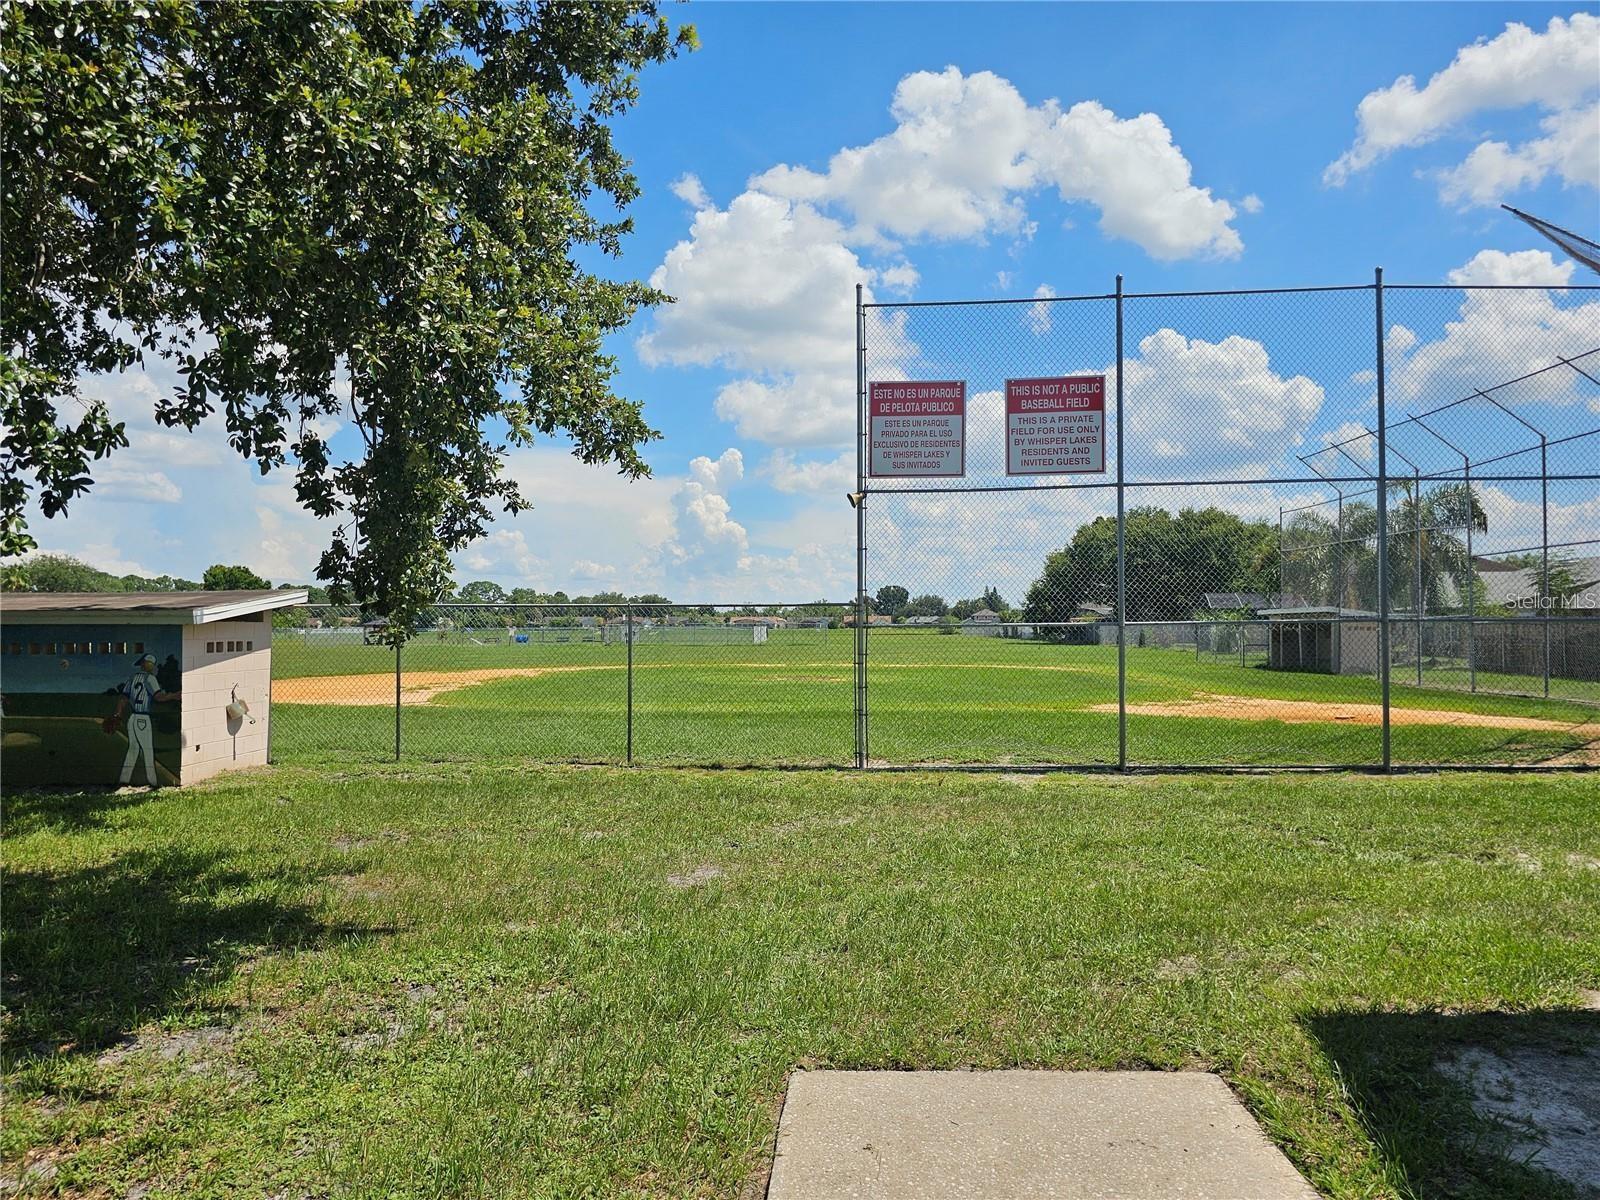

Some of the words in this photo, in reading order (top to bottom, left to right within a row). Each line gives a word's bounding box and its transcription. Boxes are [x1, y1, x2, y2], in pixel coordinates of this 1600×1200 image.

[874, 390, 892, 399] ESTE
[894, 389, 905, 398] NO
[907, 389, 916, 398] ES
[918, 389, 928, 398] UN
[931, 388, 960, 398] PARQUE
[1011, 386, 1030, 396] THIS
[1032, 386, 1040, 395] IS
[1042, 385, 1060, 395] NOT
[1062, 385, 1067, 394] A
[1070, 383, 1100, 394] PUBLIC
[880, 403, 890, 412] DE
[892, 403, 920, 412] PELOTA
[922, 402, 954, 412] PUBLICO
[1021, 399, 1064, 409] BASEBALL
[1066, 398, 1089, 408] FIELD
[134, 682, 144, 704] 2
